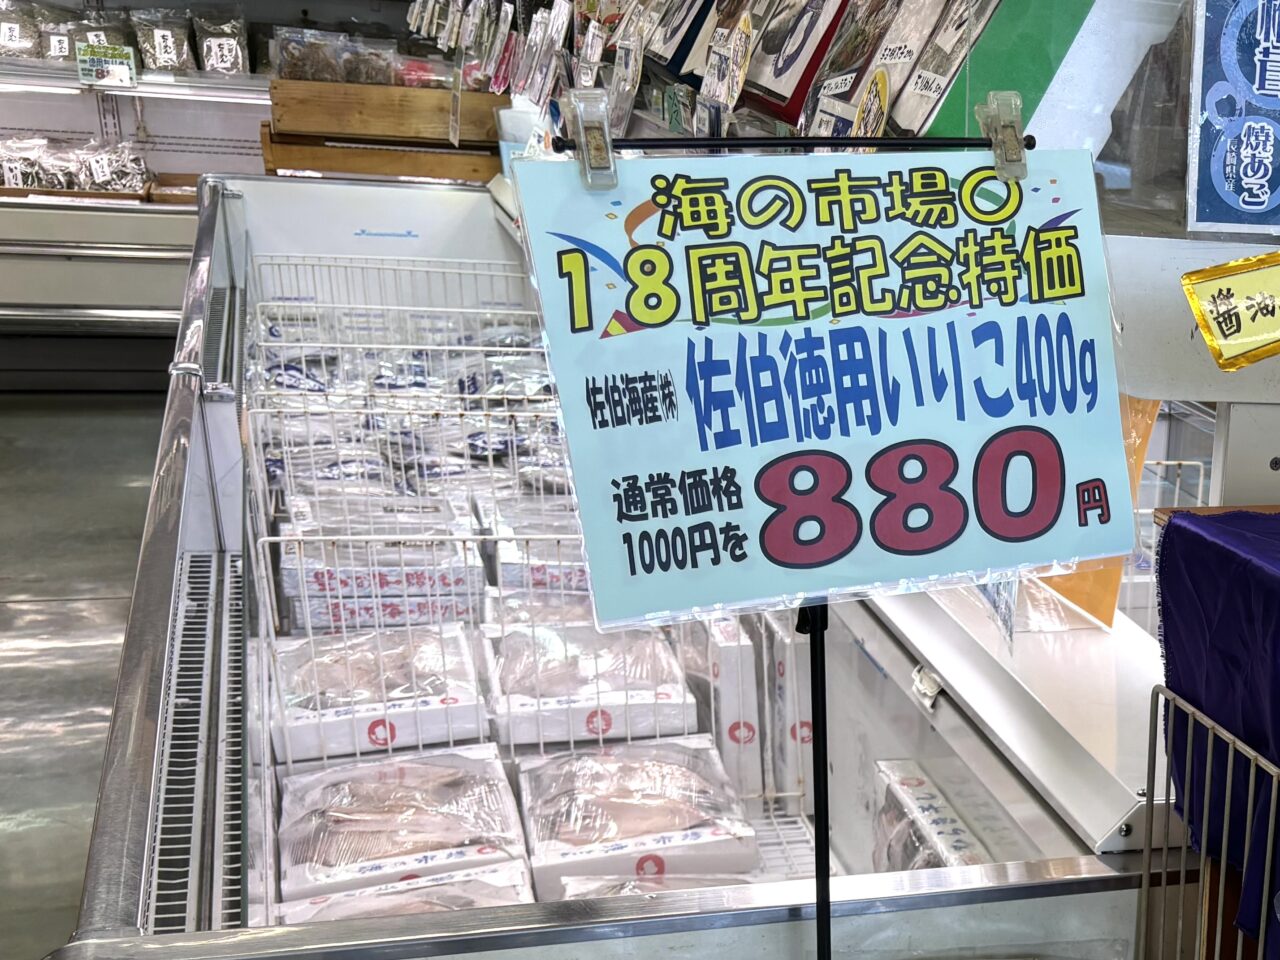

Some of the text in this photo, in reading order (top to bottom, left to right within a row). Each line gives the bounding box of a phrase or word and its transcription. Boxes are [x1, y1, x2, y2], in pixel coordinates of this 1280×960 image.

[1240, 122, 1274, 210] 焼あご
[557, 226, 1085, 333] 18周年記念特価
[685, 313, 1099, 452] 佐伯徳用いりこ400g
[612, 465, 744, 524] 通常価格
[622, 521, 750, 577] 1000円を
